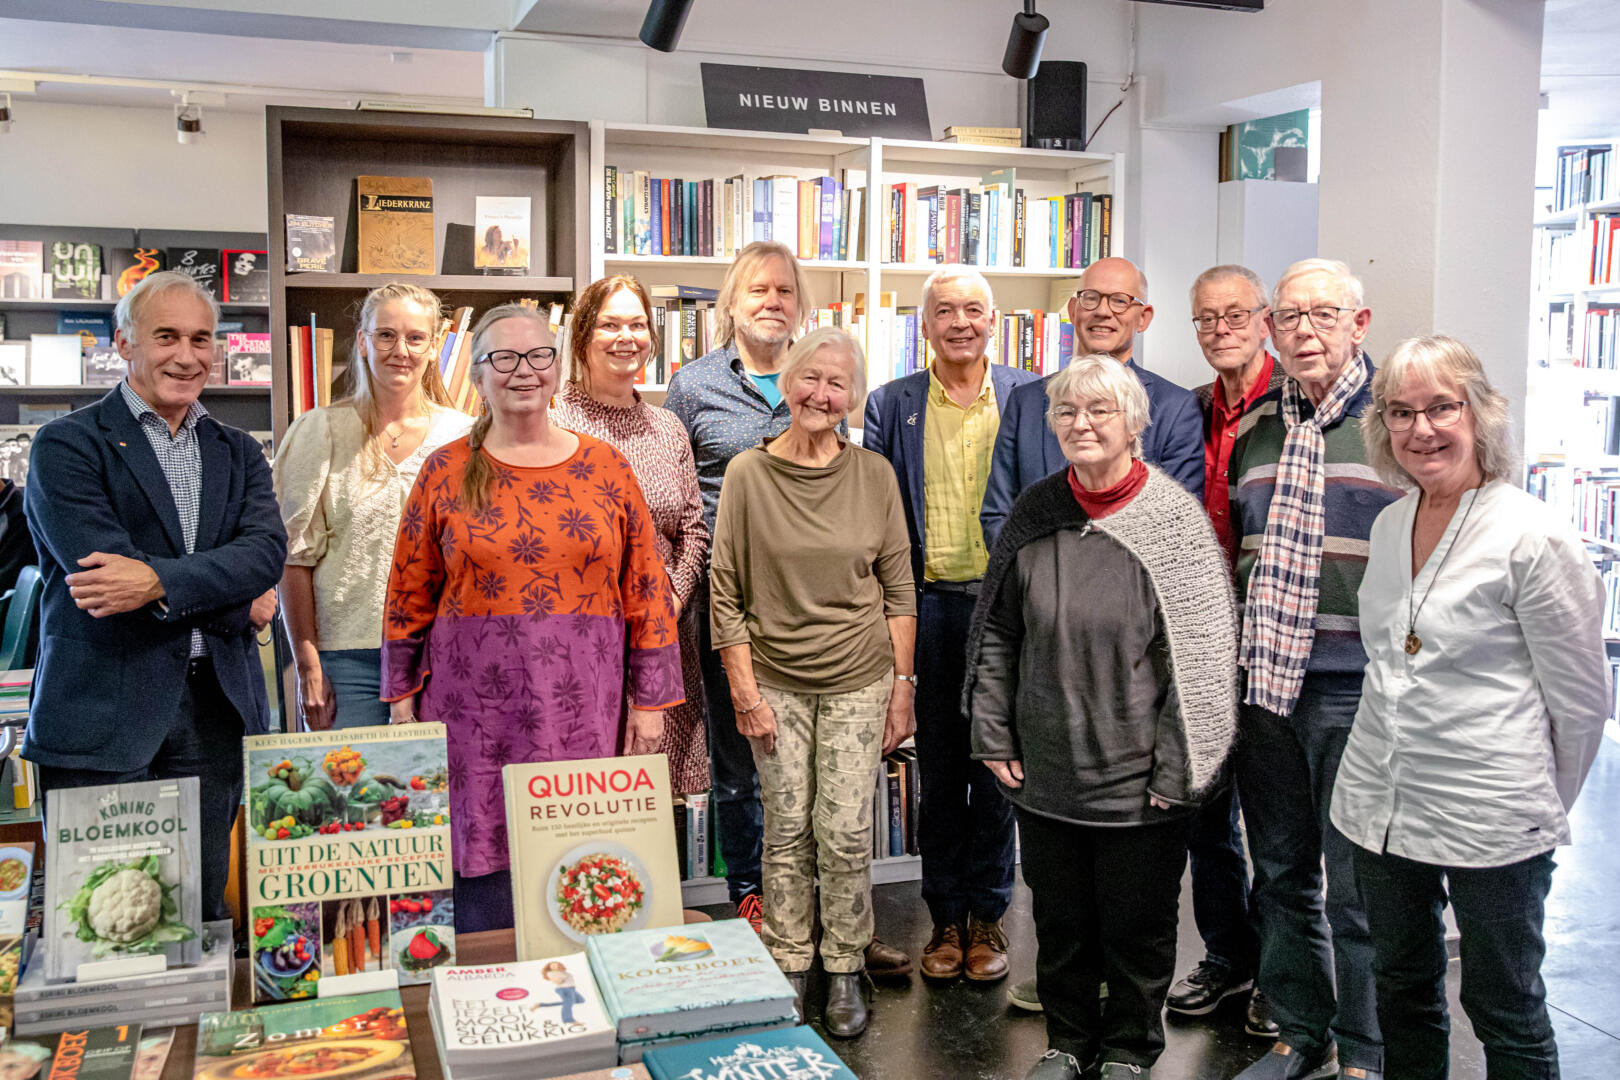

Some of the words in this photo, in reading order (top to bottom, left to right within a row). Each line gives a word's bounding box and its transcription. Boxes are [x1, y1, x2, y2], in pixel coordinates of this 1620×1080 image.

[739, 93, 809, 111] NIEUW
[818, 98, 898, 116] BINNEN
[362, 195, 431, 211] LIEDERKRANZ
[605, 216, 613, 239] MACHT
[930, 211, 938, 244] JAPANESE
[181, 250, 198, 265] 8
[254, 738, 278, 748] KEES
[280, 735, 323, 746] HAGEMAN
[329, 732, 377, 742] ELISABETH
[393, 728, 441, 739] LESTRIEUX
[528, 768, 655, 799] QUINOA
[99, 801, 156, 820] KONING
[530, 797, 657, 820] REVOLUTIE
[59, 818, 188, 844] BLOEMKOOL
[532, 824, 549, 832] Ruim
[258, 846, 301, 867] UIT
[308, 842, 341, 863] DE
[349, 834, 444, 859] NATUUR
[258, 866, 282, 875] MET
[288, 857, 382, 872] VERRUKKELIJKE
[387, 852, 446, 863] RECEPTEN
[258, 859, 445, 901] GROENTEN
[446, 967, 506, 975] AMBER
[446, 972, 516, 982] ALBARDA
[618, 956, 766, 981] KOOKBOEK
[67, 983, 119, 996] BLOEMKOOL
[67, 1004, 119, 1017] BLOEMKOOL
[452, 998, 490, 1010] EET
[455, 1004, 529, 1018] JEZELF
[455, 1014, 528, 1027] MOOI
[456, 1020, 535, 1037] SLANK
[543, 1018, 559, 1029] &
[115, 1024, 129, 1043] 1
[233, 1019, 369, 1049] Zomer
[458, 1025, 588, 1046] GELUKKIG
[697, 1051, 842, 1080] WINTER
